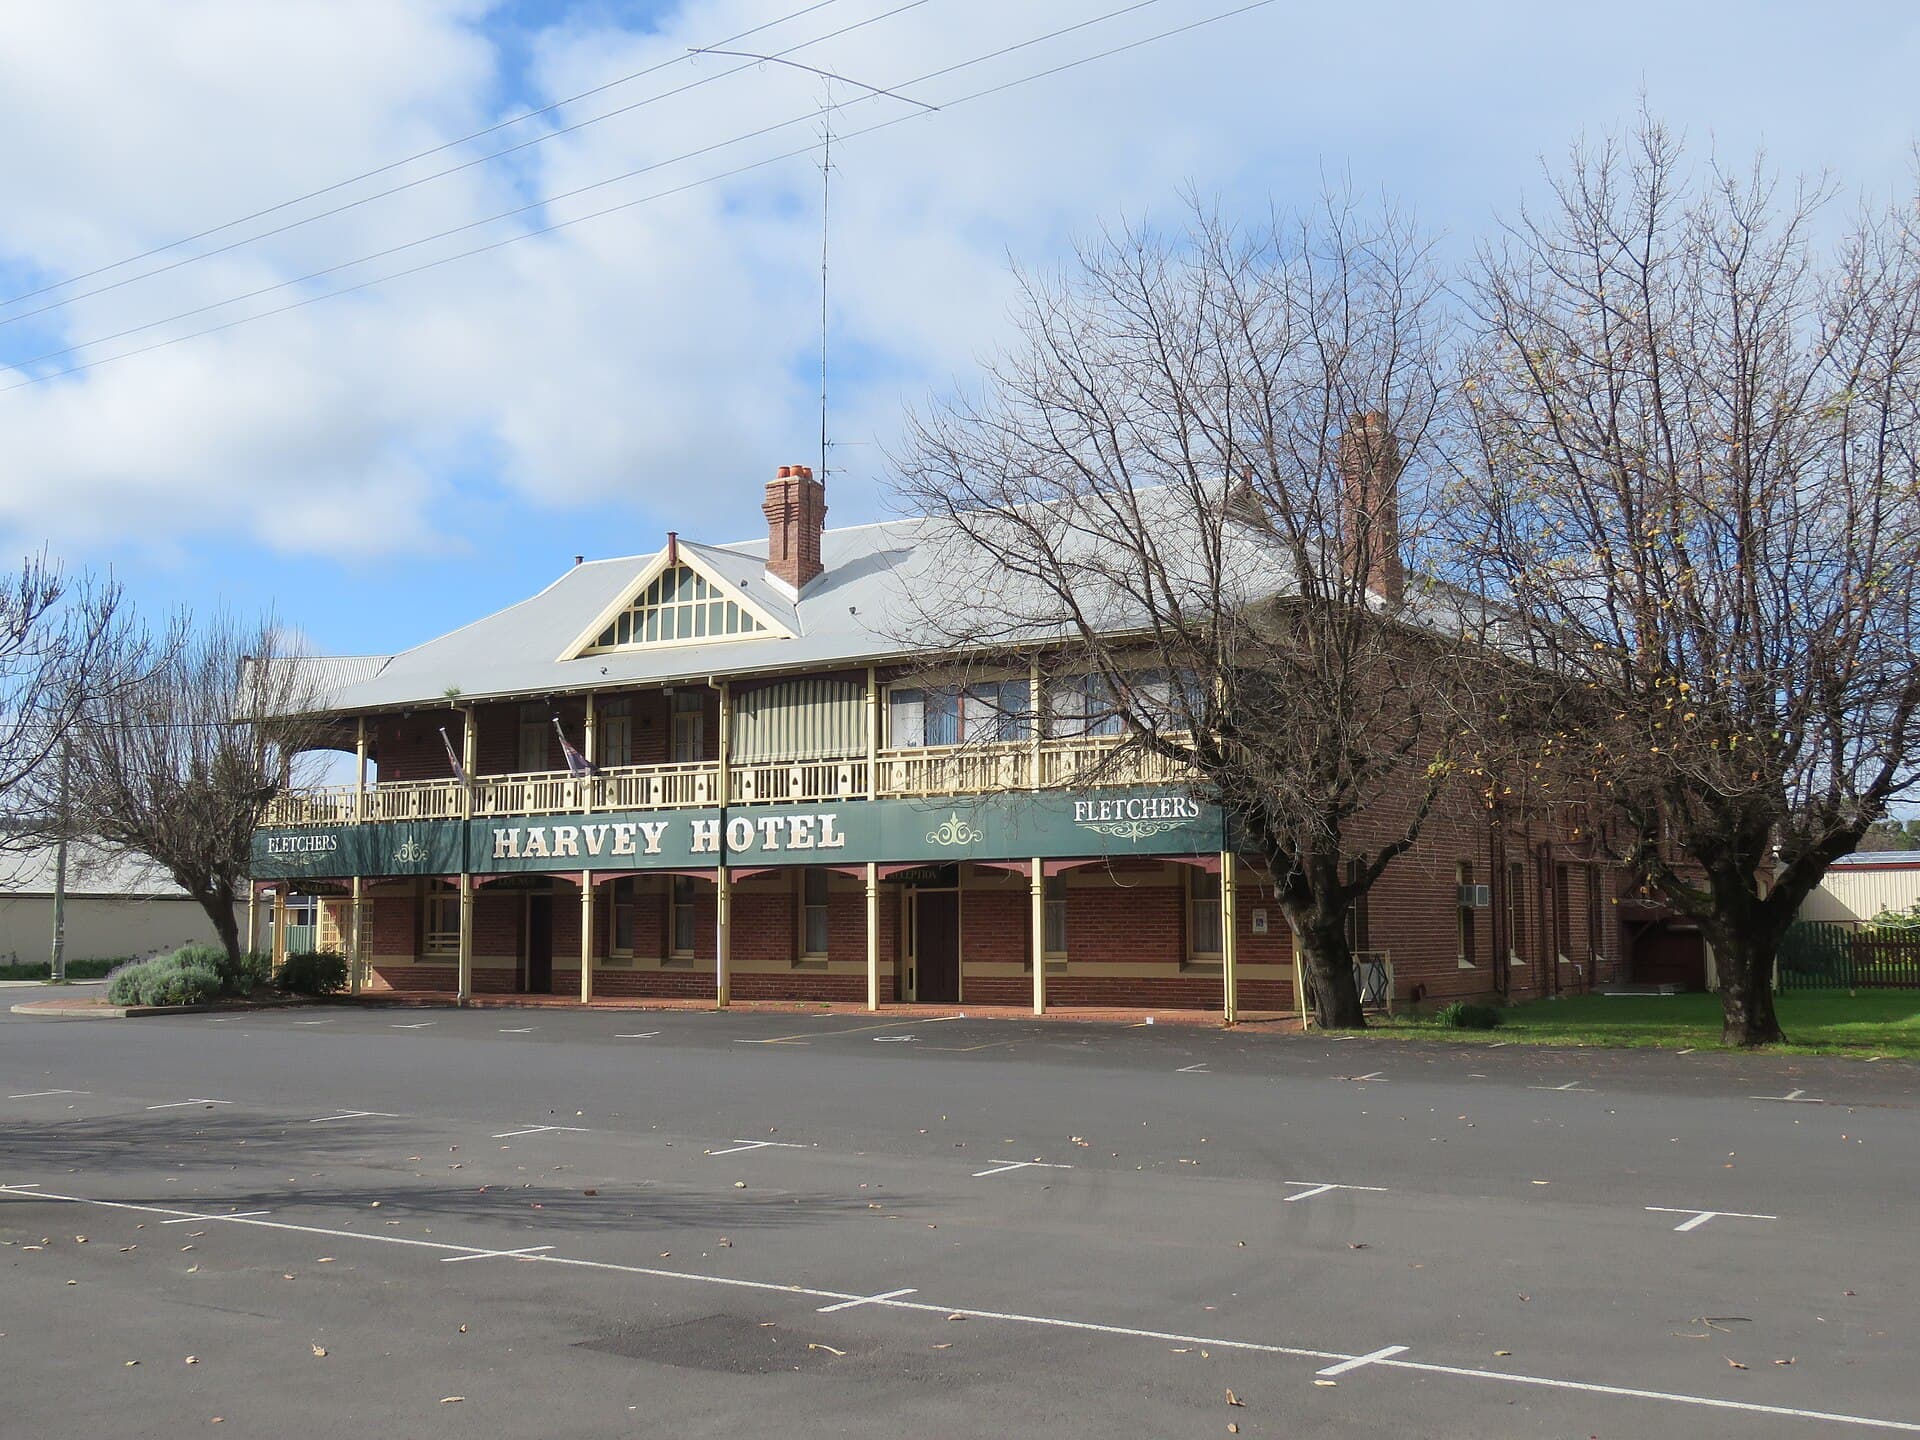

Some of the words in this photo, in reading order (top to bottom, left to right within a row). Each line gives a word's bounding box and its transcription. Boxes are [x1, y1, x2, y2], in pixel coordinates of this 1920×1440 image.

[1074, 797, 1199, 821] FLETCHERS
[267, 834, 337, 853] FLETCHERS
[493, 821, 669, 858] HARVEY
[690, 813, 845, 852] HOTEL
